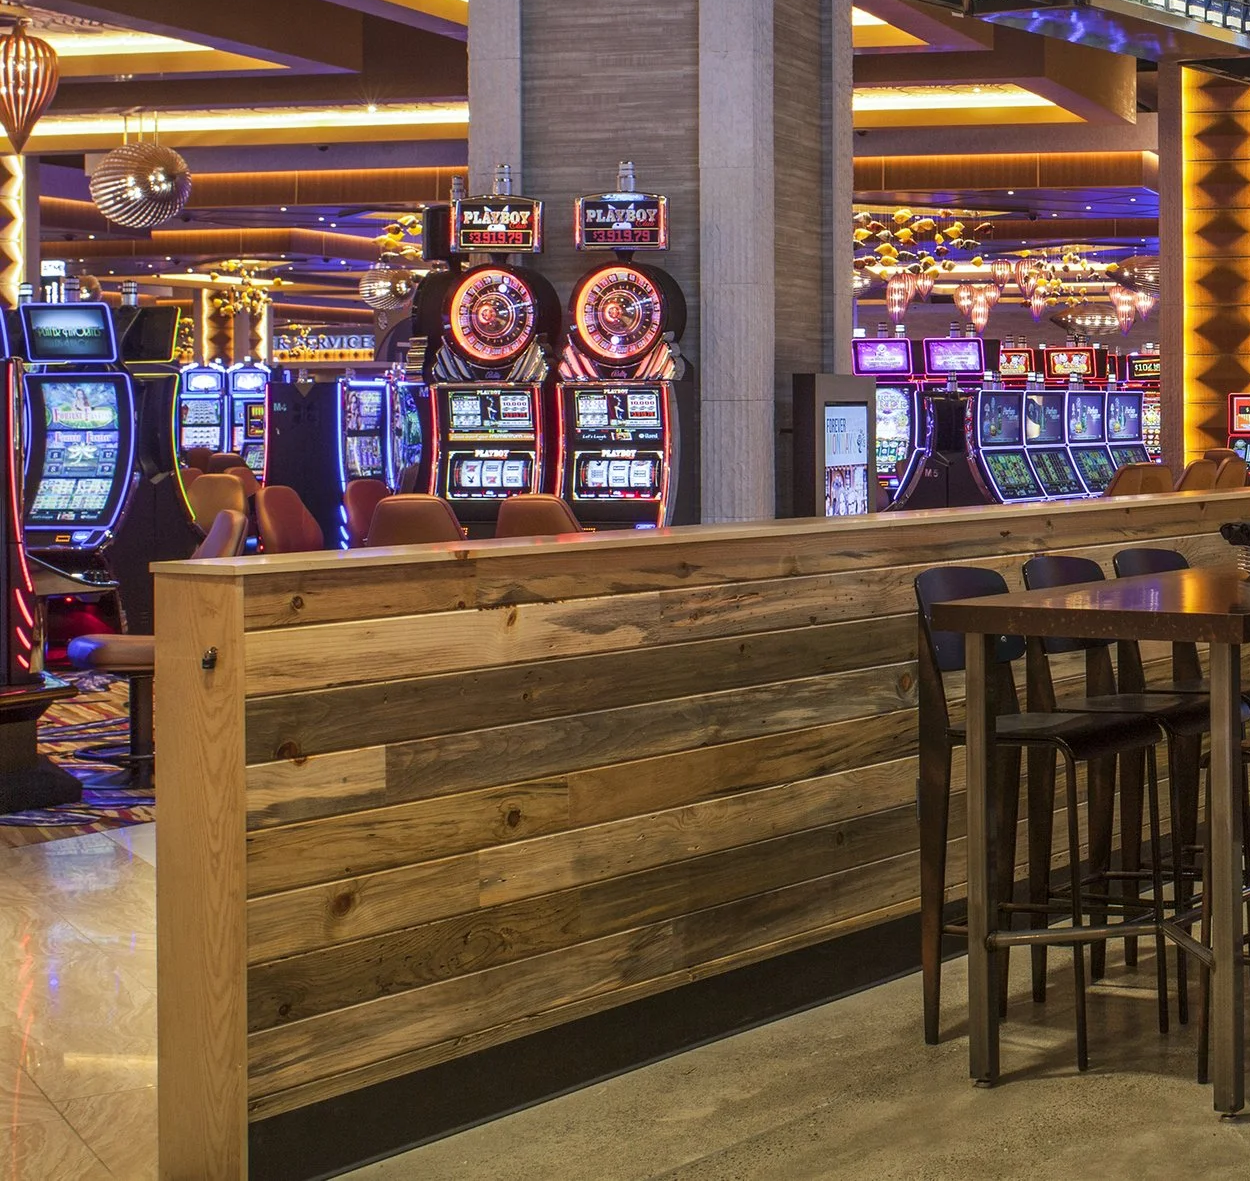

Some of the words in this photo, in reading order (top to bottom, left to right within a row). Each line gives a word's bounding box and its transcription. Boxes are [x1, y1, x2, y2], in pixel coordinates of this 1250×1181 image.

[463, 211, 531, 224] PLAYBOY
[586, 209, 658, 222] PLAYBOY
[827, 418, 846, 433] FOREVER
[474, 450, 509, 458] PLAYBOY
[601, 449, 637, 457] PLAYBOY
